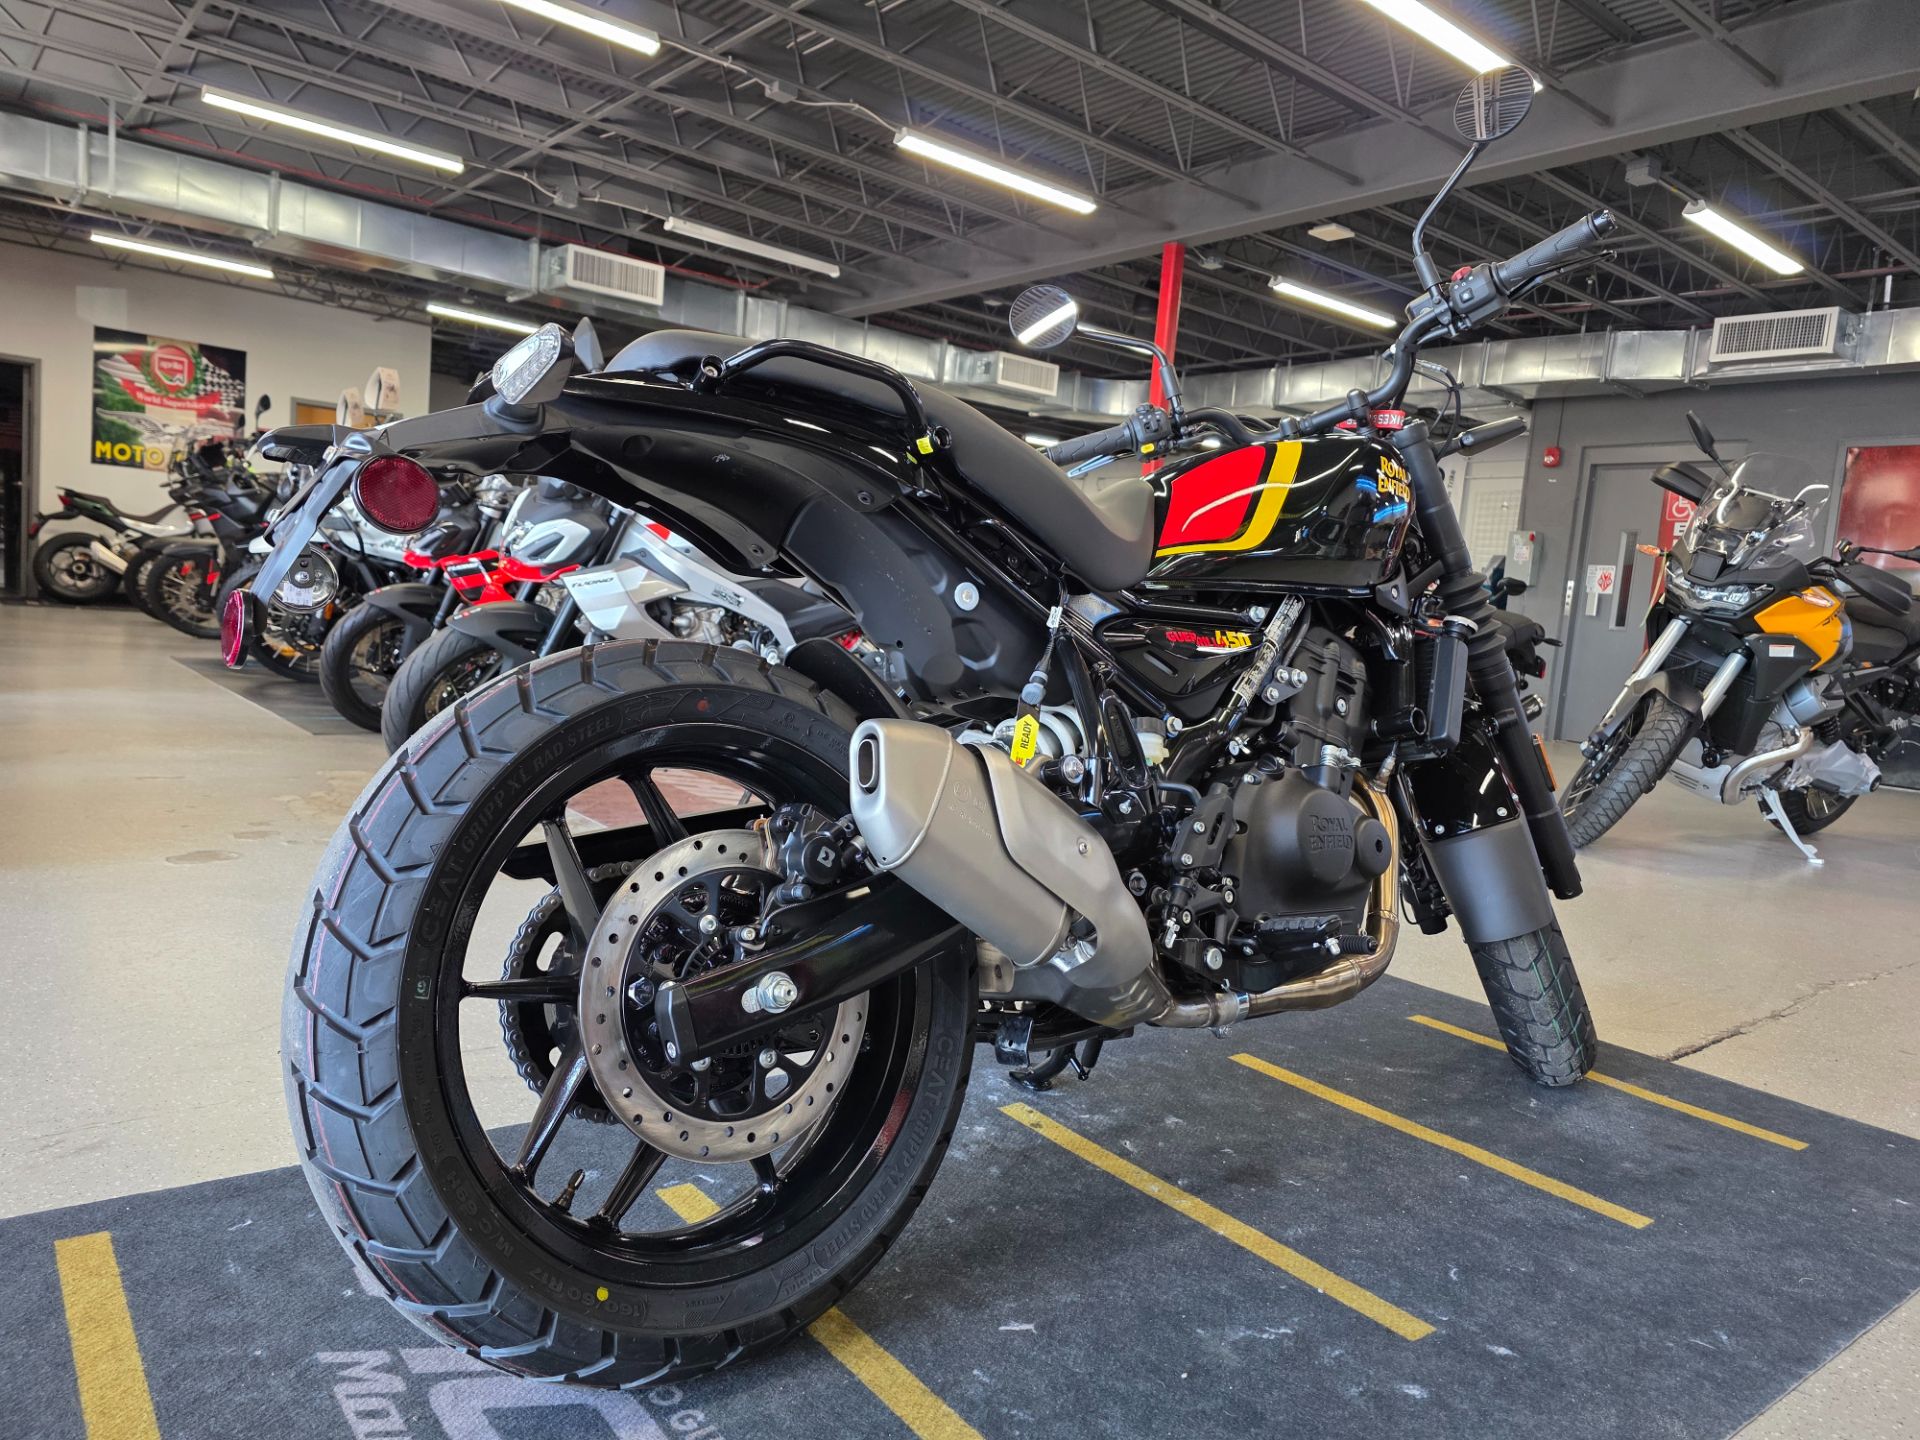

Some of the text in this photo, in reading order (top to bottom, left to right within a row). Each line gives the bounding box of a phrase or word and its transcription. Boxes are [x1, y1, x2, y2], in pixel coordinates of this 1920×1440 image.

[95, 440, 164, 465] MOTO
[1380, 455, 1412, 483] ROYAL
[1378, 475, 1411, 503] ENFIELD
[1214, 629, 1253, 649] 450
[532, 742, 565, 773] RAD
[567, 715, 616, 747] STEEL
[1020, 720, 1032, 750] READY
[1308, 814, 1348, 833] ROYAL
[1308, 834, 1353, 851] ENFIELD
[861, 1187, 889, 1223] RAD
[823, 1214, 862, 1259] STEEL
